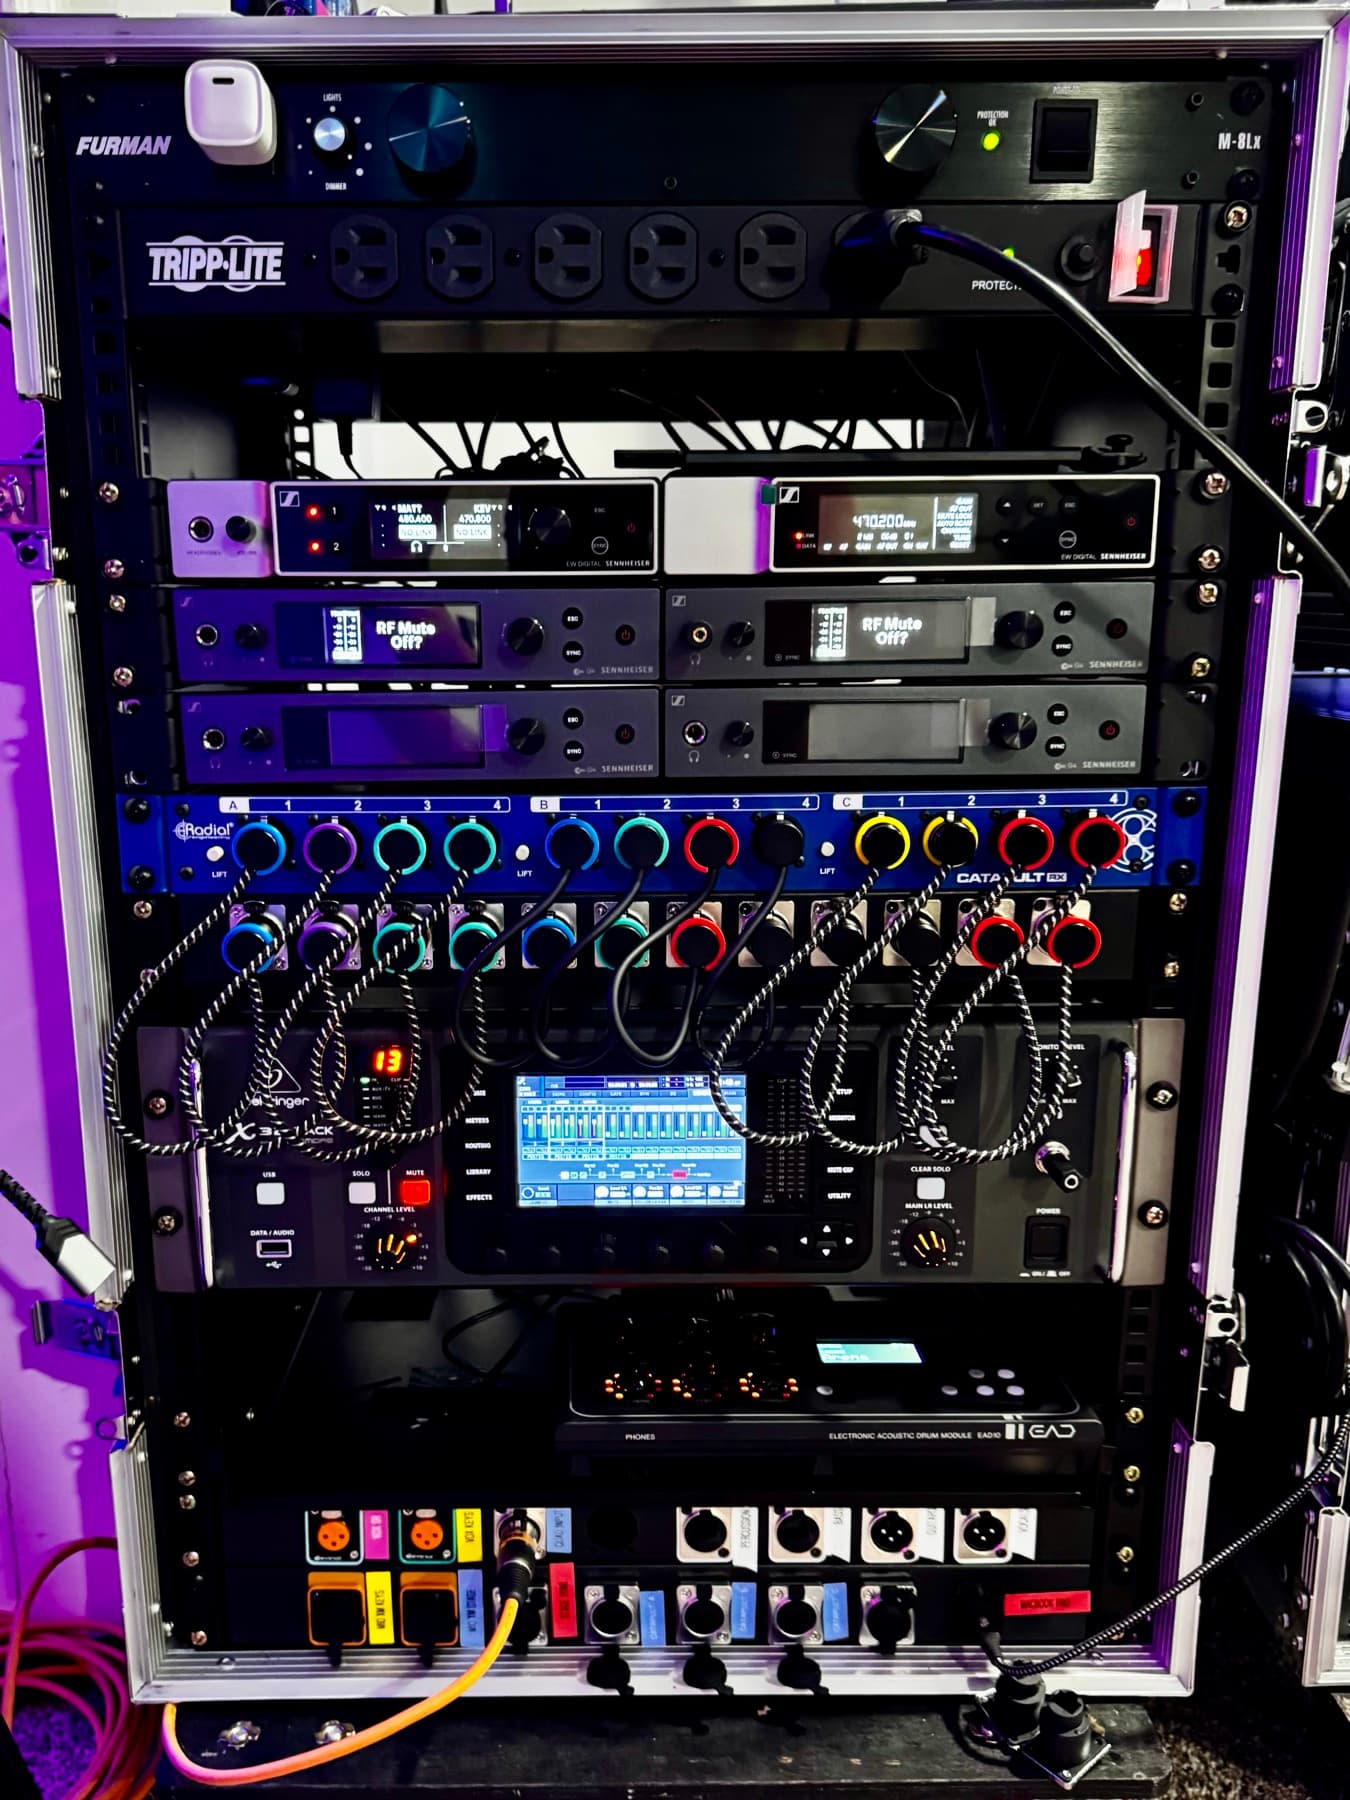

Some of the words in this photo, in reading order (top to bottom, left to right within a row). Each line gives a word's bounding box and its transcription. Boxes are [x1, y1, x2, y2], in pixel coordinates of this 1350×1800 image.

[323, 93, 342, 101] LIGHTS
[75, 135, 172, 155] FURMAN
[1218, 132, 1262, 150] M-8Lx
[332, 506, 338, 515] 1
[397, 503, 422, 514] MATT
[333, 542, 340, 551] 2
[376, 621, 395, 635] RF
[397, 621, 436, 635] Mute
[862, 617, 882, 631] RF
[885, 617, 923, 631] Mute
[390, 635, 423, 650] Off?
[875, 631, 909, 646] Off?
[1089, 660, 1143, 668] SENNHEISER
[601, 666, 653, 674] SENNHEISER
[601, 765, 654, 773] SENNHEISER
[1082, 761, 1136, 769] SENNHEISER
[228, 800, 239, 811] A
[284, 800, 292, 811] 1
[354, 800, 362, 811] 2
[423, 800, 432, 811] 3
[493, 800, 502, 811] 4
[540, 799, 549, 810] B
[594, 799, 601, 810] 1
[663, 799, 671, 810] 2
[732, 799, 740, 810] 3
[801, 798, 811, 809] 4
[842, 796, 851, 808] C
[898, 796, 905, 807] 1
[967, 796, 976, 807] 2
[1038, 795, 1047, 806] 3
[1109, 793, 1119, 804] 4
[212, 871, 228, 879] LIFT
[819, 867, 836, 875] LIFT
[957, 872, 1046, 883] CATAULT
[372, 1049, 403, 1073] 13
[933, 1202, 953, 1210] LEVEL
[1028, 1424, 1076, 1438] EAD
[464, 1512, 474, 1528] KEYS
[740, 1509, 751, 1549] PERCUSSION
[374, 1590, 385, 1606] KEYS
[1020, 1599, 1055, 1609] MACBOOK
